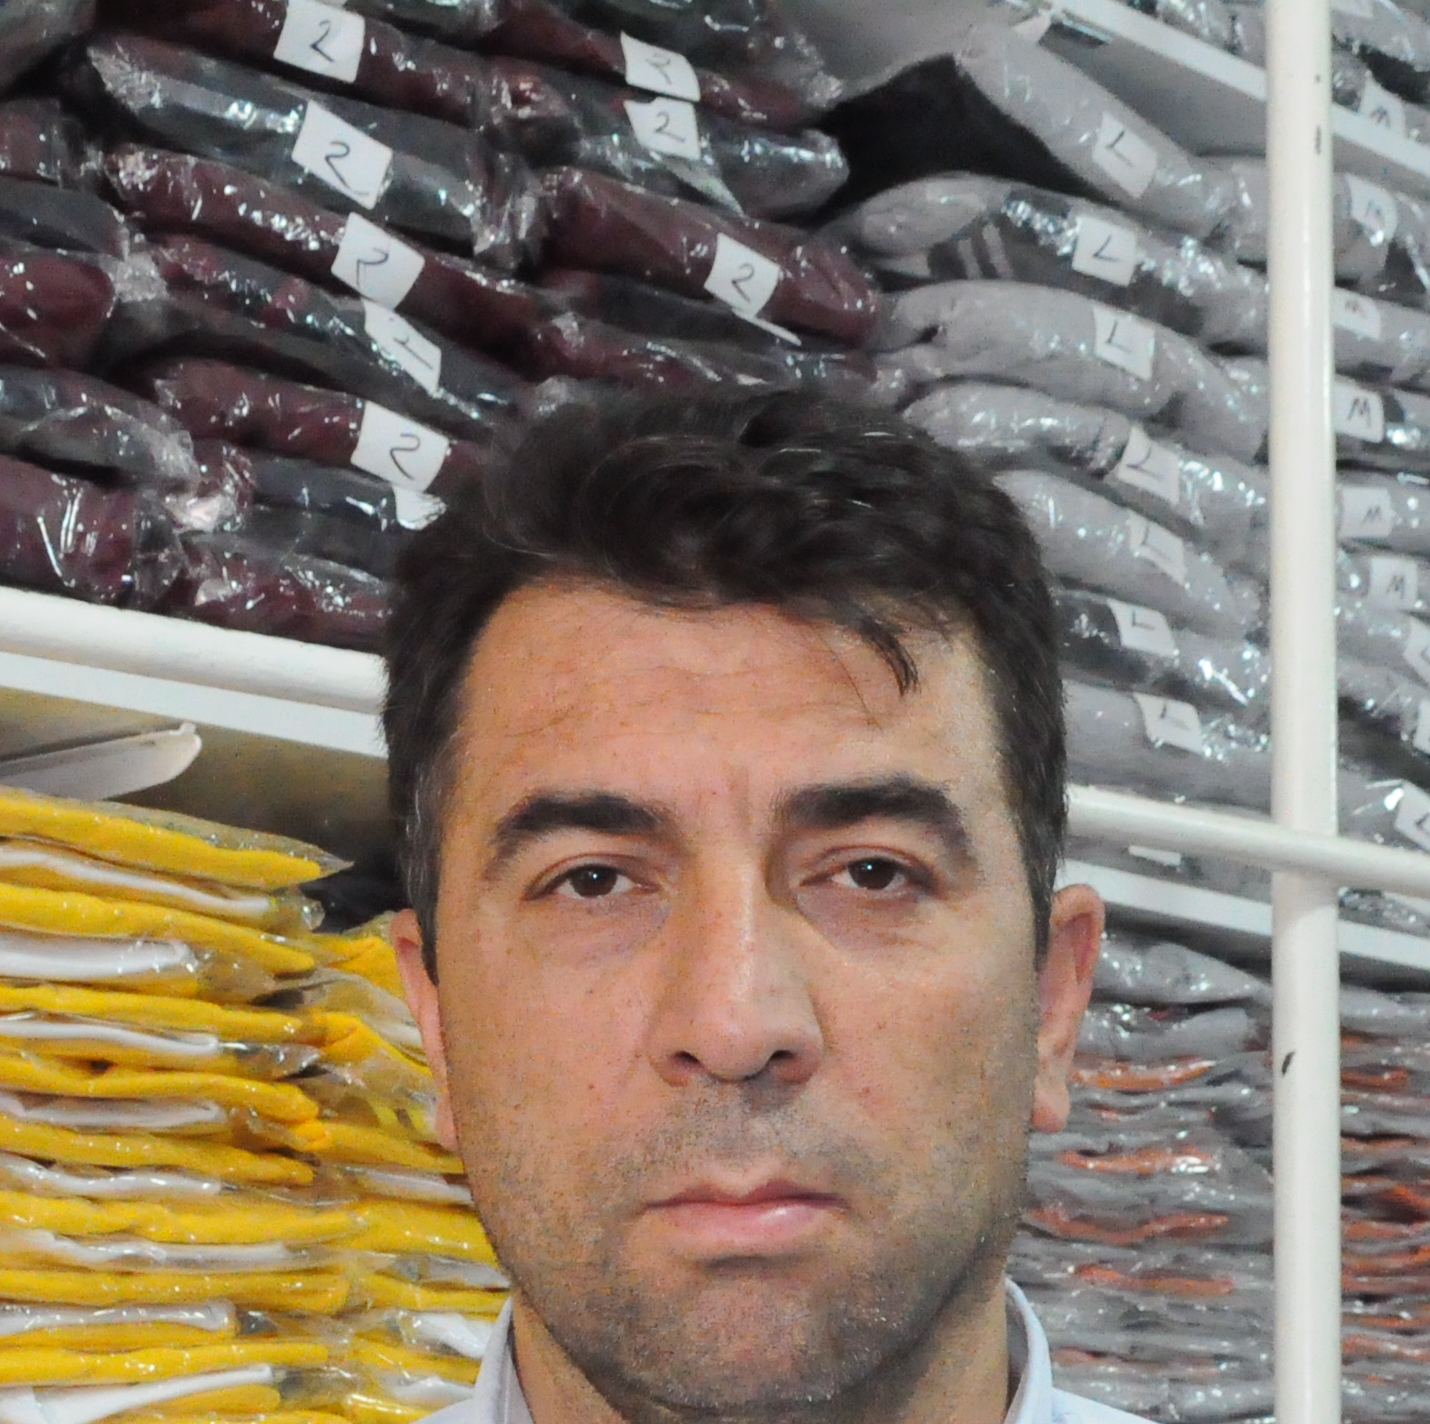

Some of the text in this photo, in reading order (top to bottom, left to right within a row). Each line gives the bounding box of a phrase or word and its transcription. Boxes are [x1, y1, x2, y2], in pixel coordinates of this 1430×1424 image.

[310, 19, 336, 63] 2
[655, 111, 686, 143] 2
[325, 141, 370, 196] 2
[732, 263, 755, 302] 2
[390, 433, 420, 481] 2
